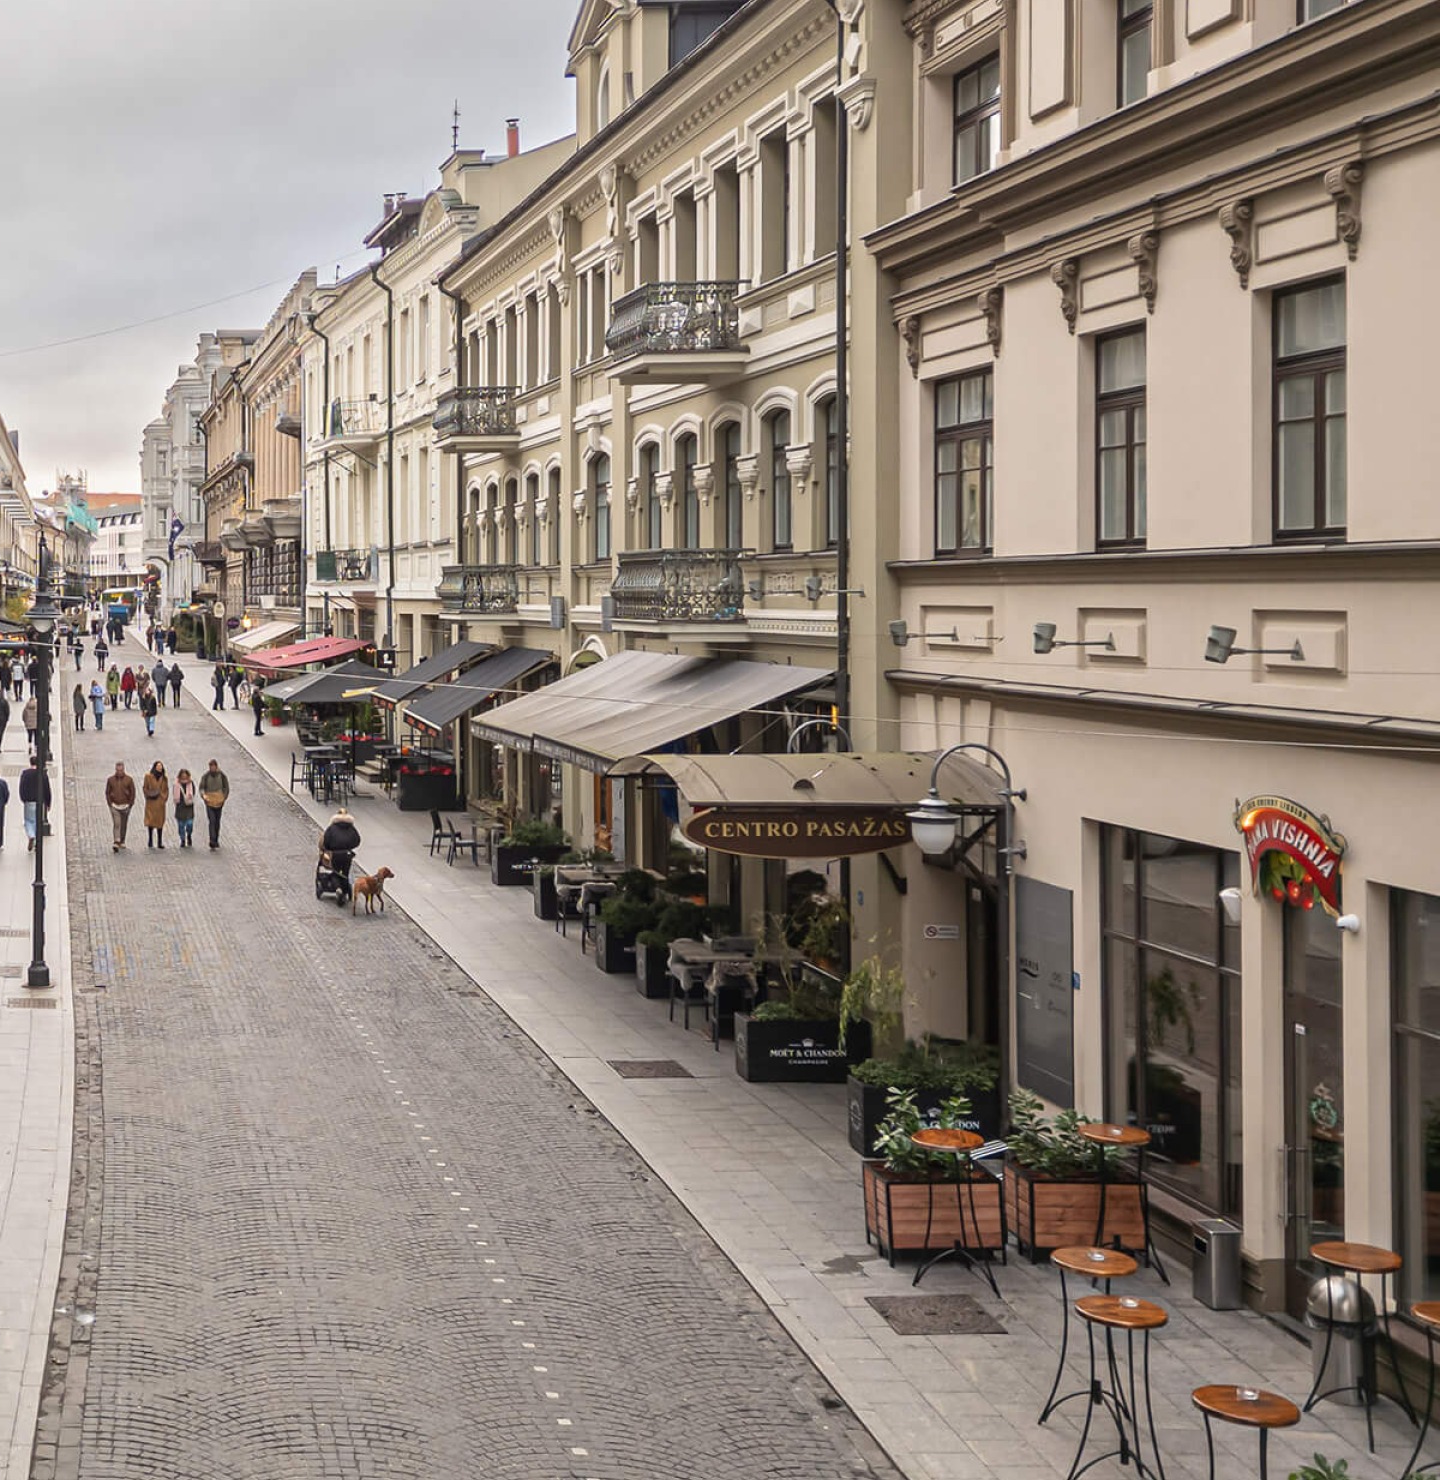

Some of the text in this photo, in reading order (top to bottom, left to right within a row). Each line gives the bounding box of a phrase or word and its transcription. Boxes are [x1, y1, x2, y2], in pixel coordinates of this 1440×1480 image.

[704, 816, 906, 838] CENTRO PASAŽAS
[1271, 818, 1336, 878] VYSHNIA
[804, 1049, 847, 1058] CHANDON
[930, 1120, 980, 1130] CDON
